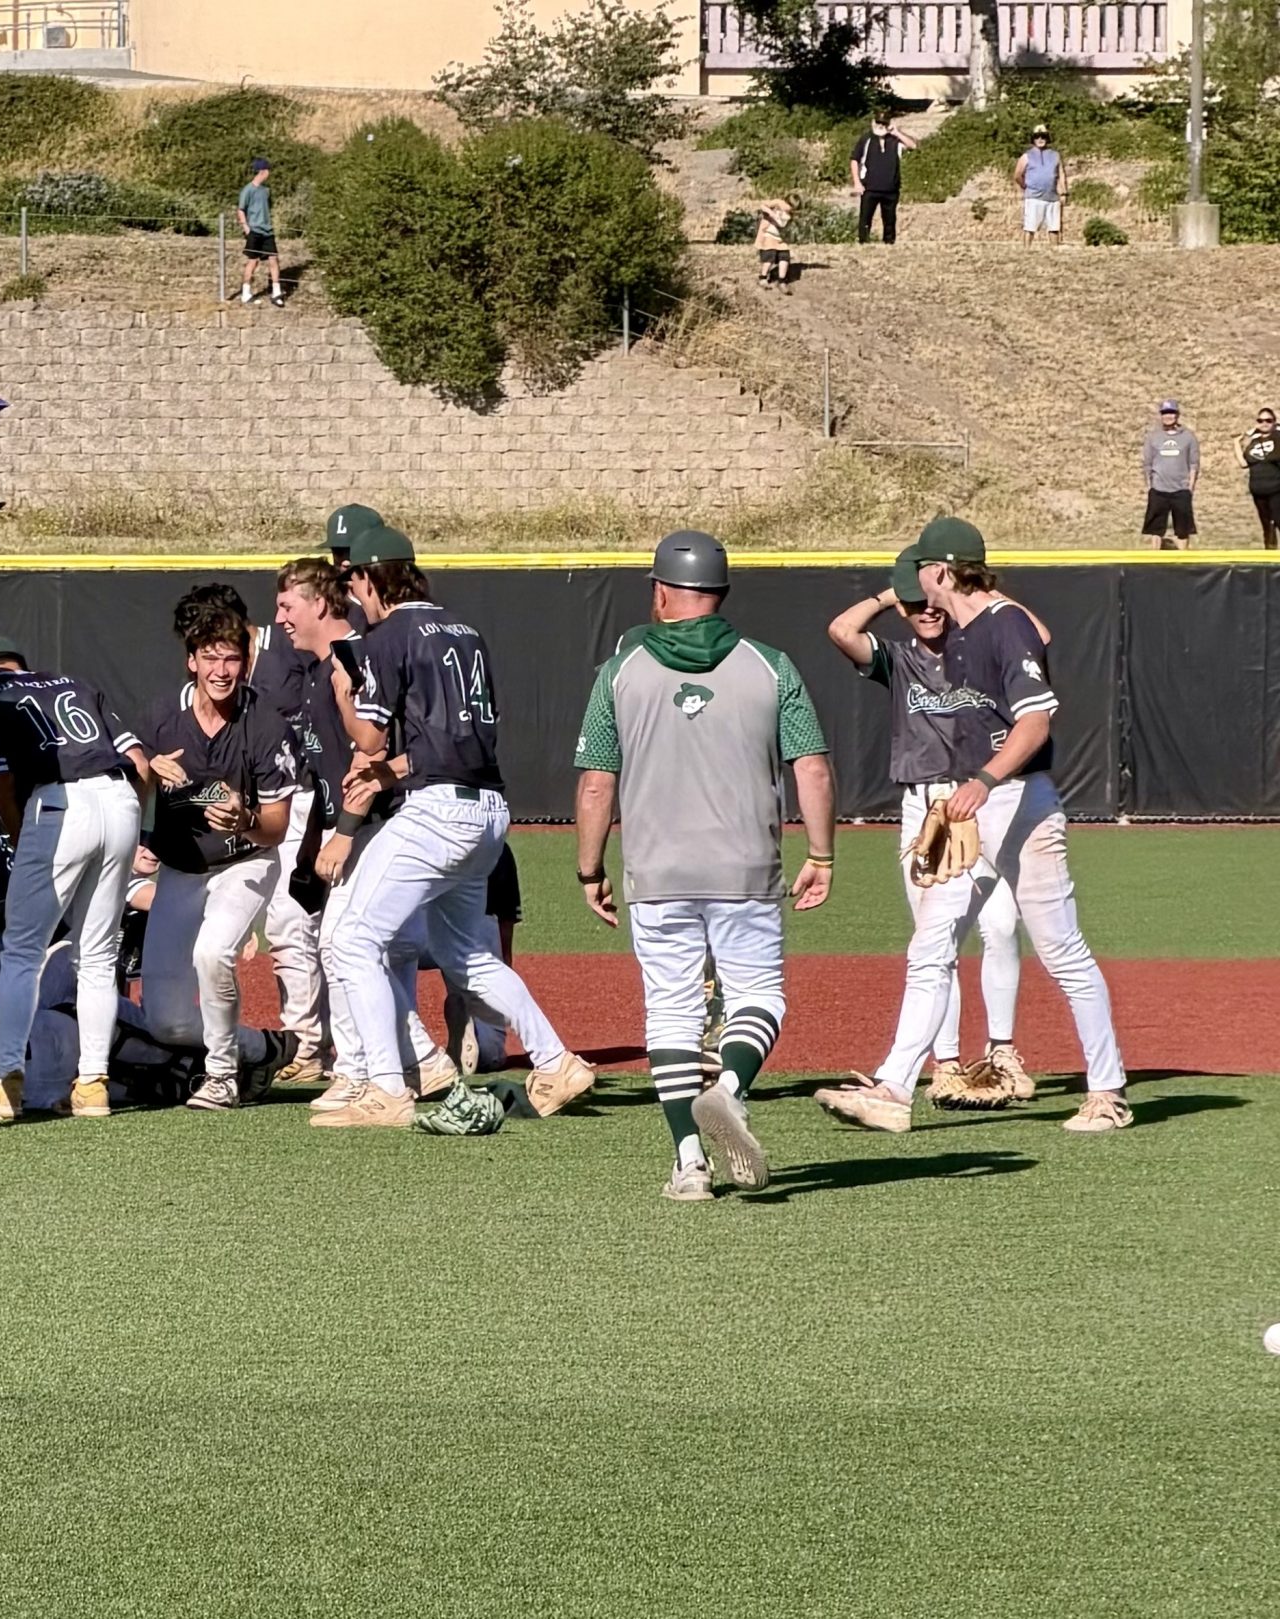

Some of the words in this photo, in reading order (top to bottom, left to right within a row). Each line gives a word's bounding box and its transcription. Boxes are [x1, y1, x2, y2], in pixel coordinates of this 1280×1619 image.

[336, 514, 348, 535] L
[442, 646, 495, 724] 14
[16, 690, 100, 751] 16
